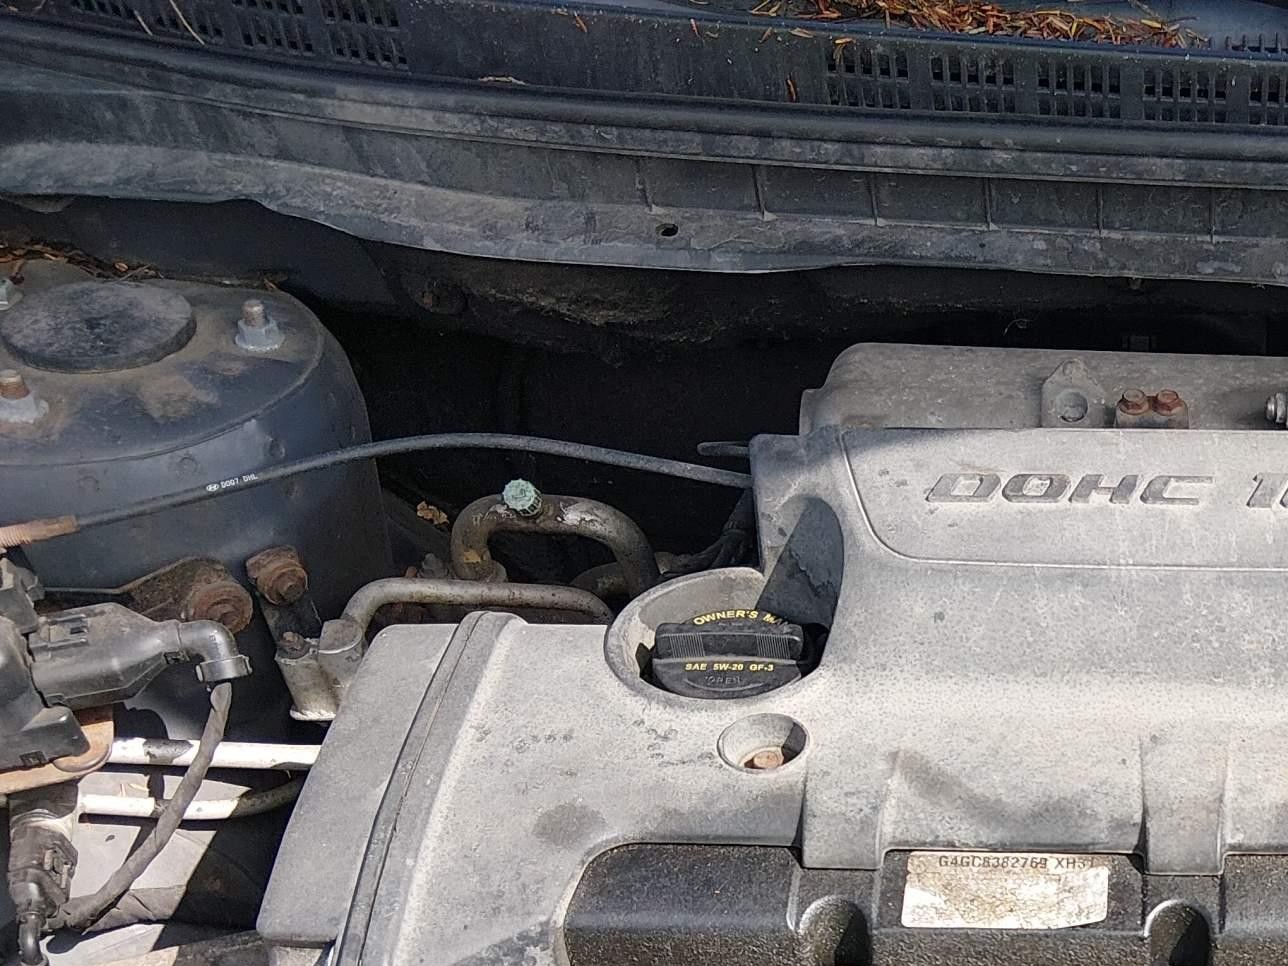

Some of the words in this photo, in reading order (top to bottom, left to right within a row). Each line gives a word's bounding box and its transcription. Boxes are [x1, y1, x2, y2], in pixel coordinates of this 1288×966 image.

[924, 472, 1214, 505] DOHC
[693, 609, 758, 625] OWNER'S
[685, 663, 707, 671] SAE
[713, 663, 744, 671] 5W-20
[749, 663, 774, 672] GF-3
